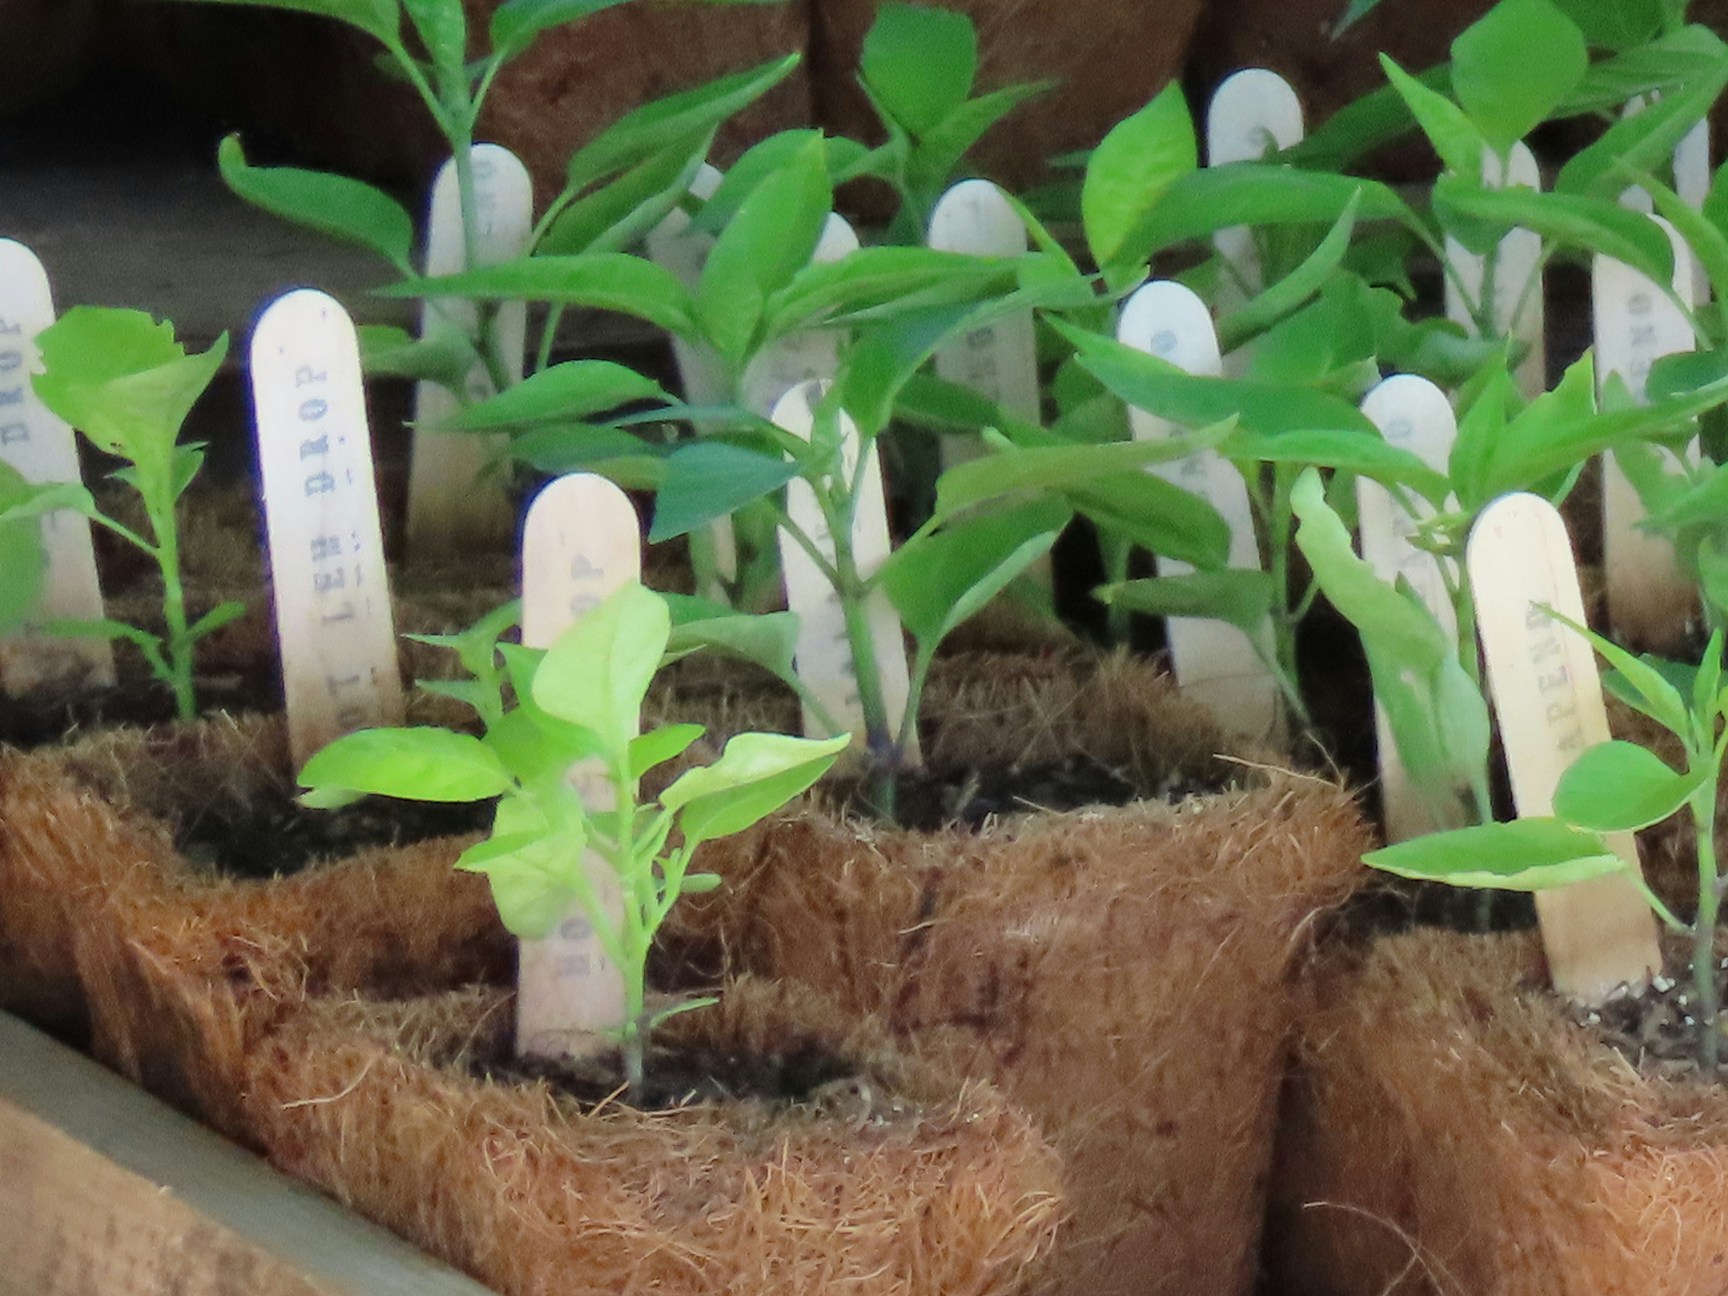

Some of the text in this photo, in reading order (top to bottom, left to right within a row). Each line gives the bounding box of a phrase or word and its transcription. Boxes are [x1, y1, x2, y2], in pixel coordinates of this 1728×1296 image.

[293, 364, 337, 496] DROP
[309, 535, 357, 624] LEM
[1524, 598, 1583, 752] APENO
